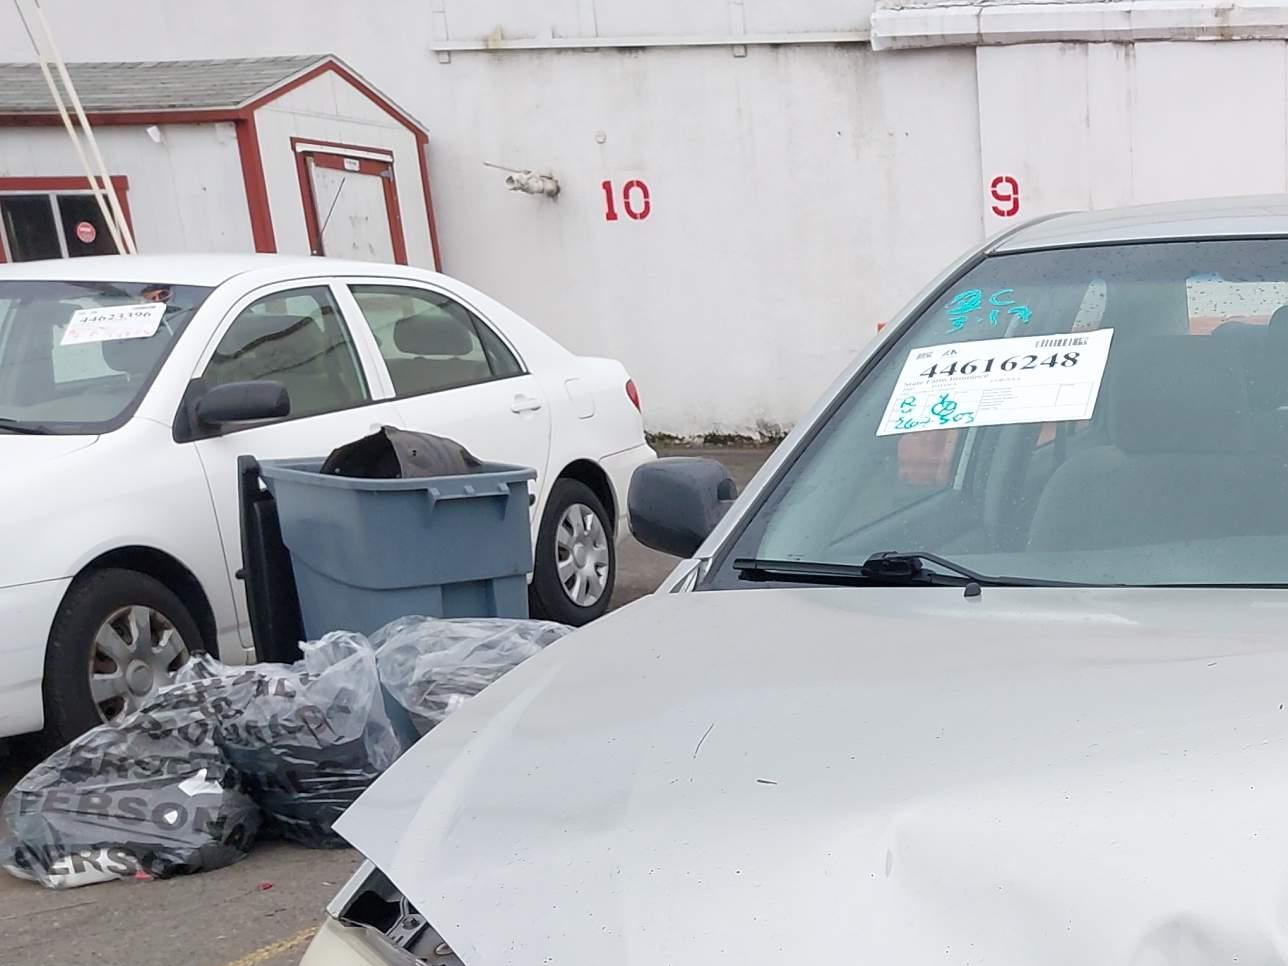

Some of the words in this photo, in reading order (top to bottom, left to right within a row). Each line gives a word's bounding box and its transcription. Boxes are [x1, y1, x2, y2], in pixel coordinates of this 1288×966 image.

[602, 180, 650, 220] 10
[991, 176, 1019, 217] 9
[920, 351, 1080, 378] 44616248
